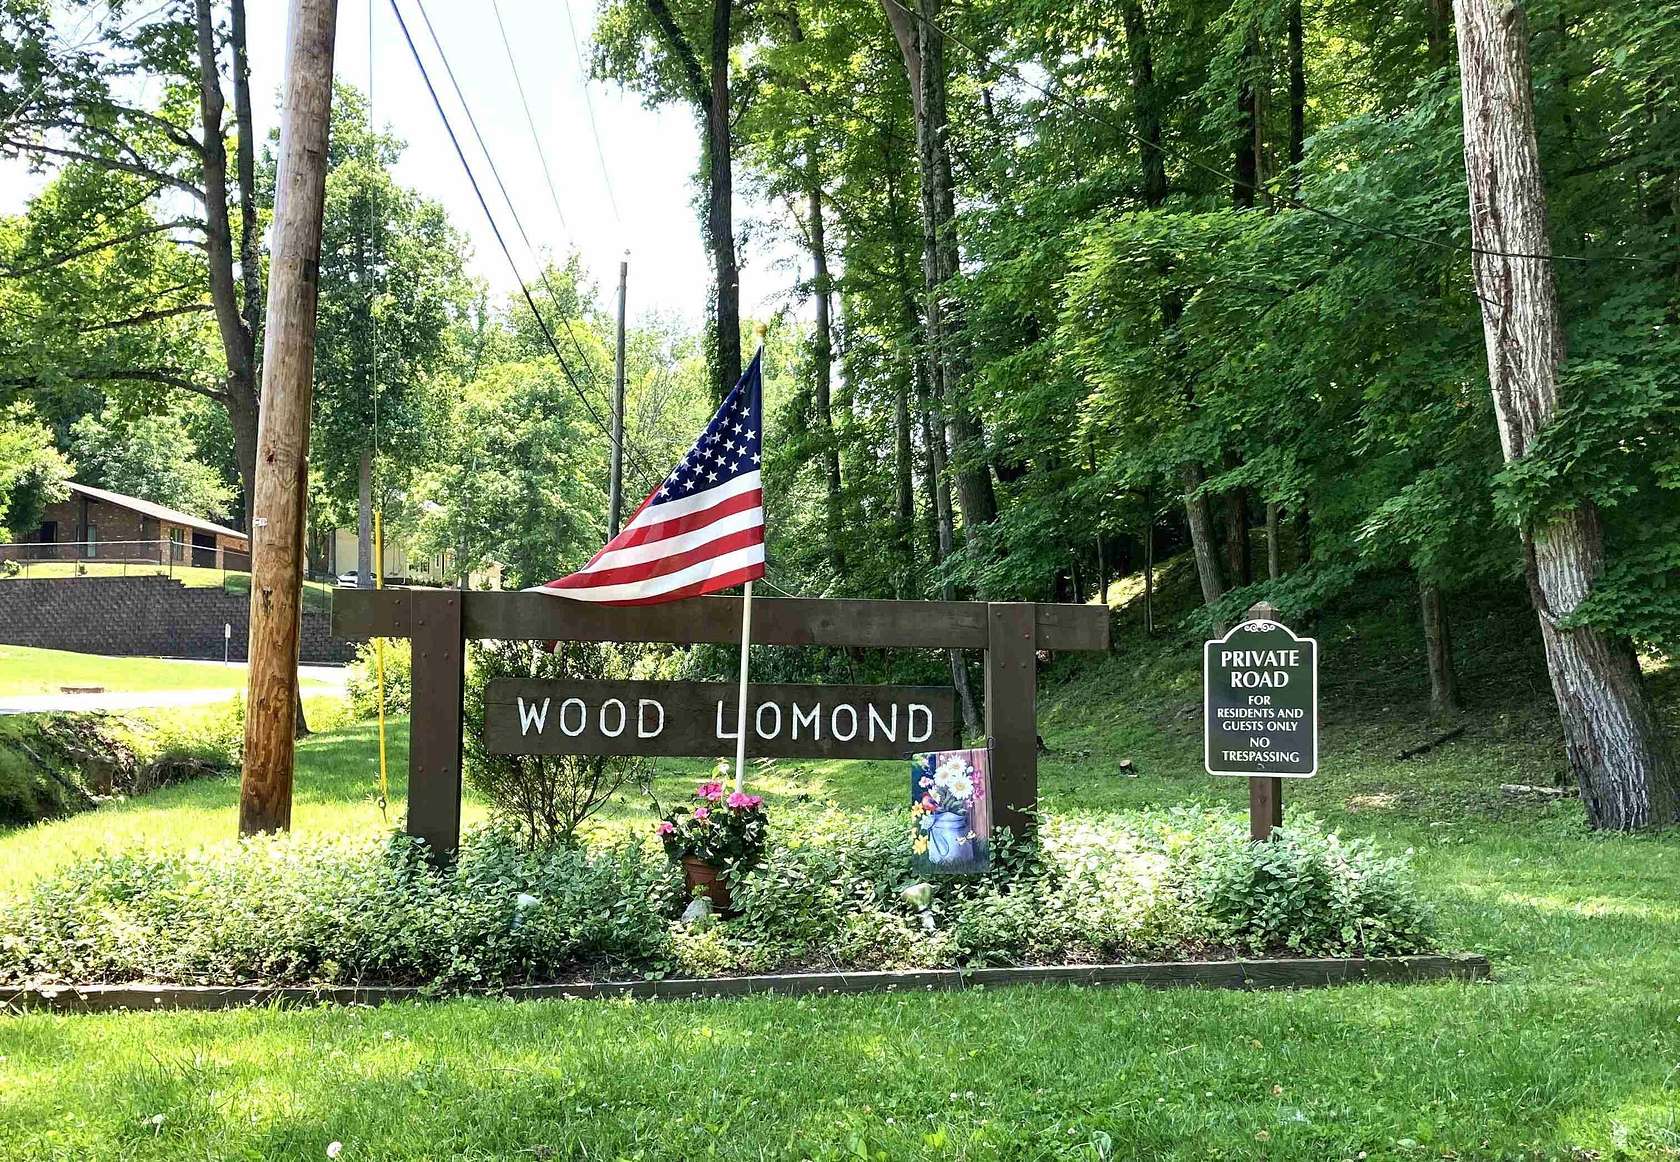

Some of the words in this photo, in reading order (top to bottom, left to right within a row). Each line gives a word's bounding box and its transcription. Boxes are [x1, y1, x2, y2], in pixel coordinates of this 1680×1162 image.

[1221, 649, 1300, 668] PRIVATE
[1230, 670, 1290, 688] ROAD
[1248, 695, 1271, 706] FOR
[517, 696, 665, 738] WOOD
[716, 699, 934, 743] LOMOND
[1217, 707, 1275, 719] RESIDENTS
[1277, 708, 1304, 719] AND
[1222, 720, 1264, 732] GUESTS
[1266, 720, 1298, 732] ONLY
[1249, 736, 1271, 749] NO
[1221, 750, 1300, 763] TRESPASSING
